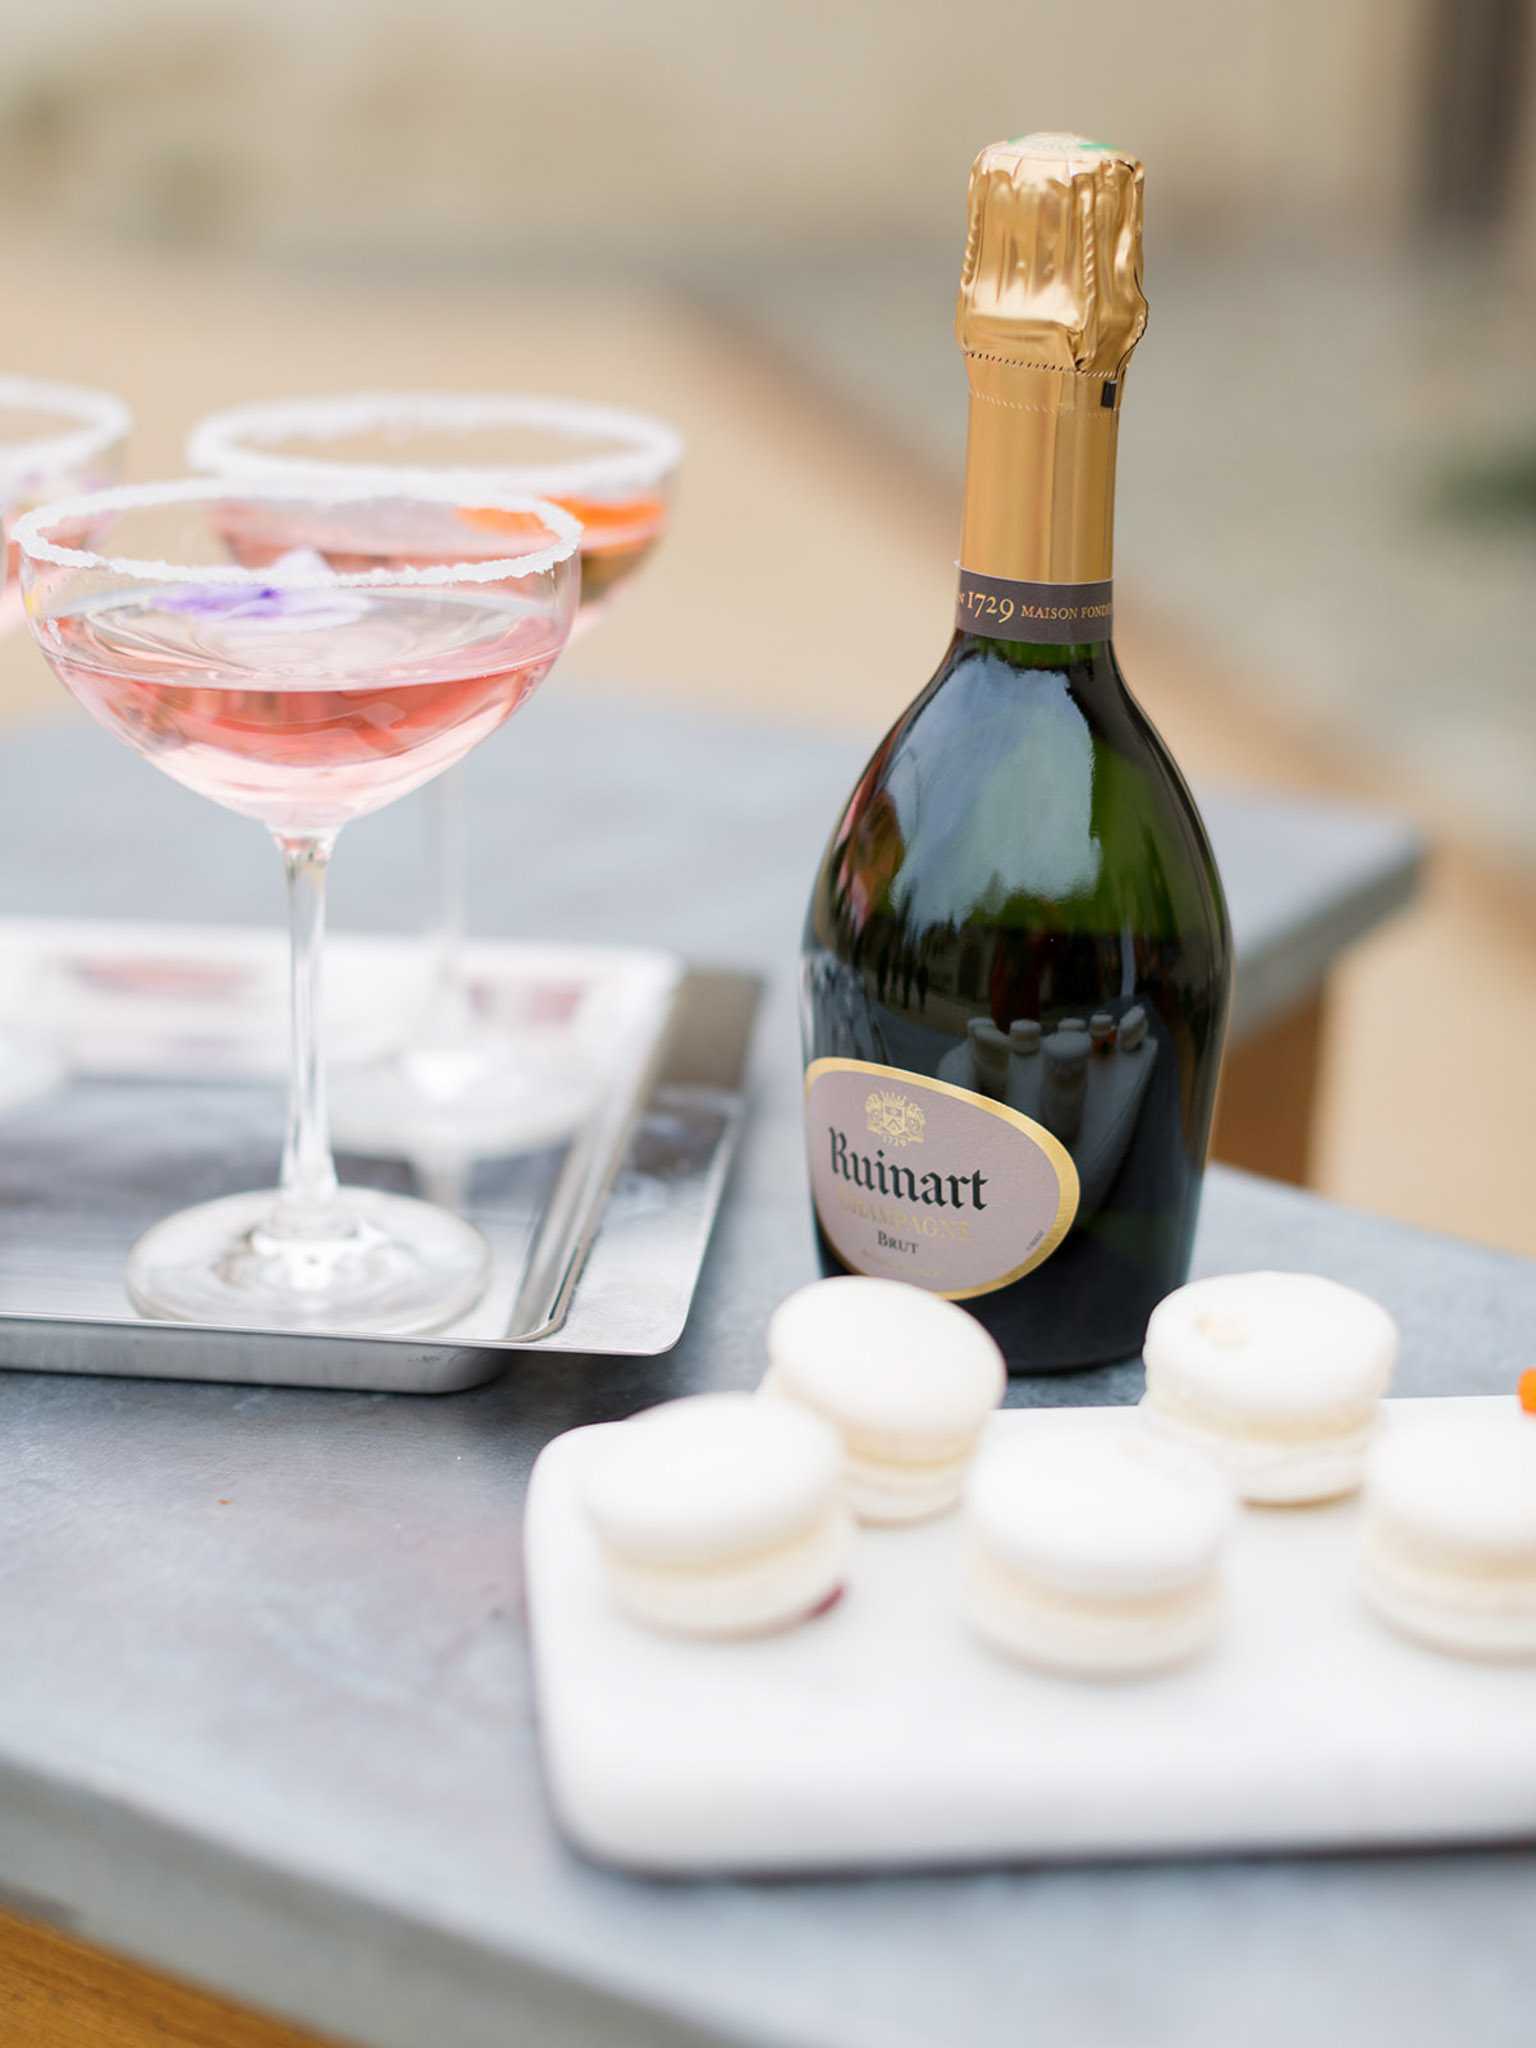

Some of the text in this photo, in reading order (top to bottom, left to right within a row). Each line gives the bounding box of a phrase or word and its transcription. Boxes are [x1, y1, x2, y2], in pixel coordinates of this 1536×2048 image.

[967, 591, 1014, 623] 1729
[1021, 604, 1077, 620] MAISON
[829, 1126, 989, 1210] Ruinart
